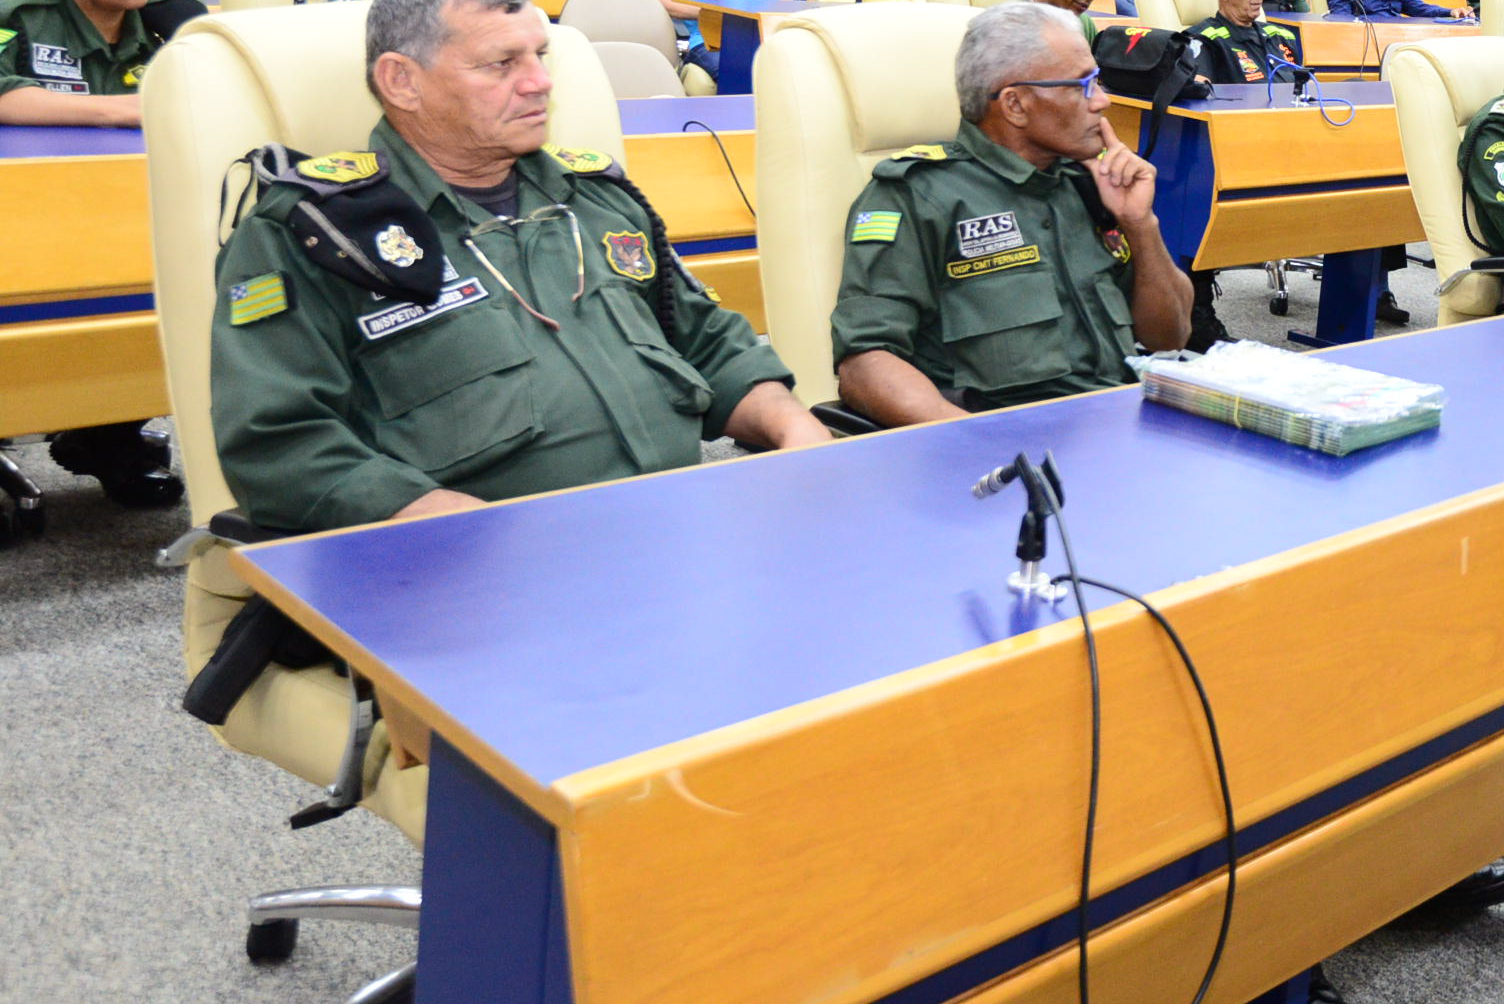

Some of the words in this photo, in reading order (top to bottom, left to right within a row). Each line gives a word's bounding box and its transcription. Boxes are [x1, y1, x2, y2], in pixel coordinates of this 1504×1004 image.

[963, 215, 1013, 240] RAS
[993, 250, 1035, 266] FERNANDO
[369, 305, 425, 332] INSPETOR
